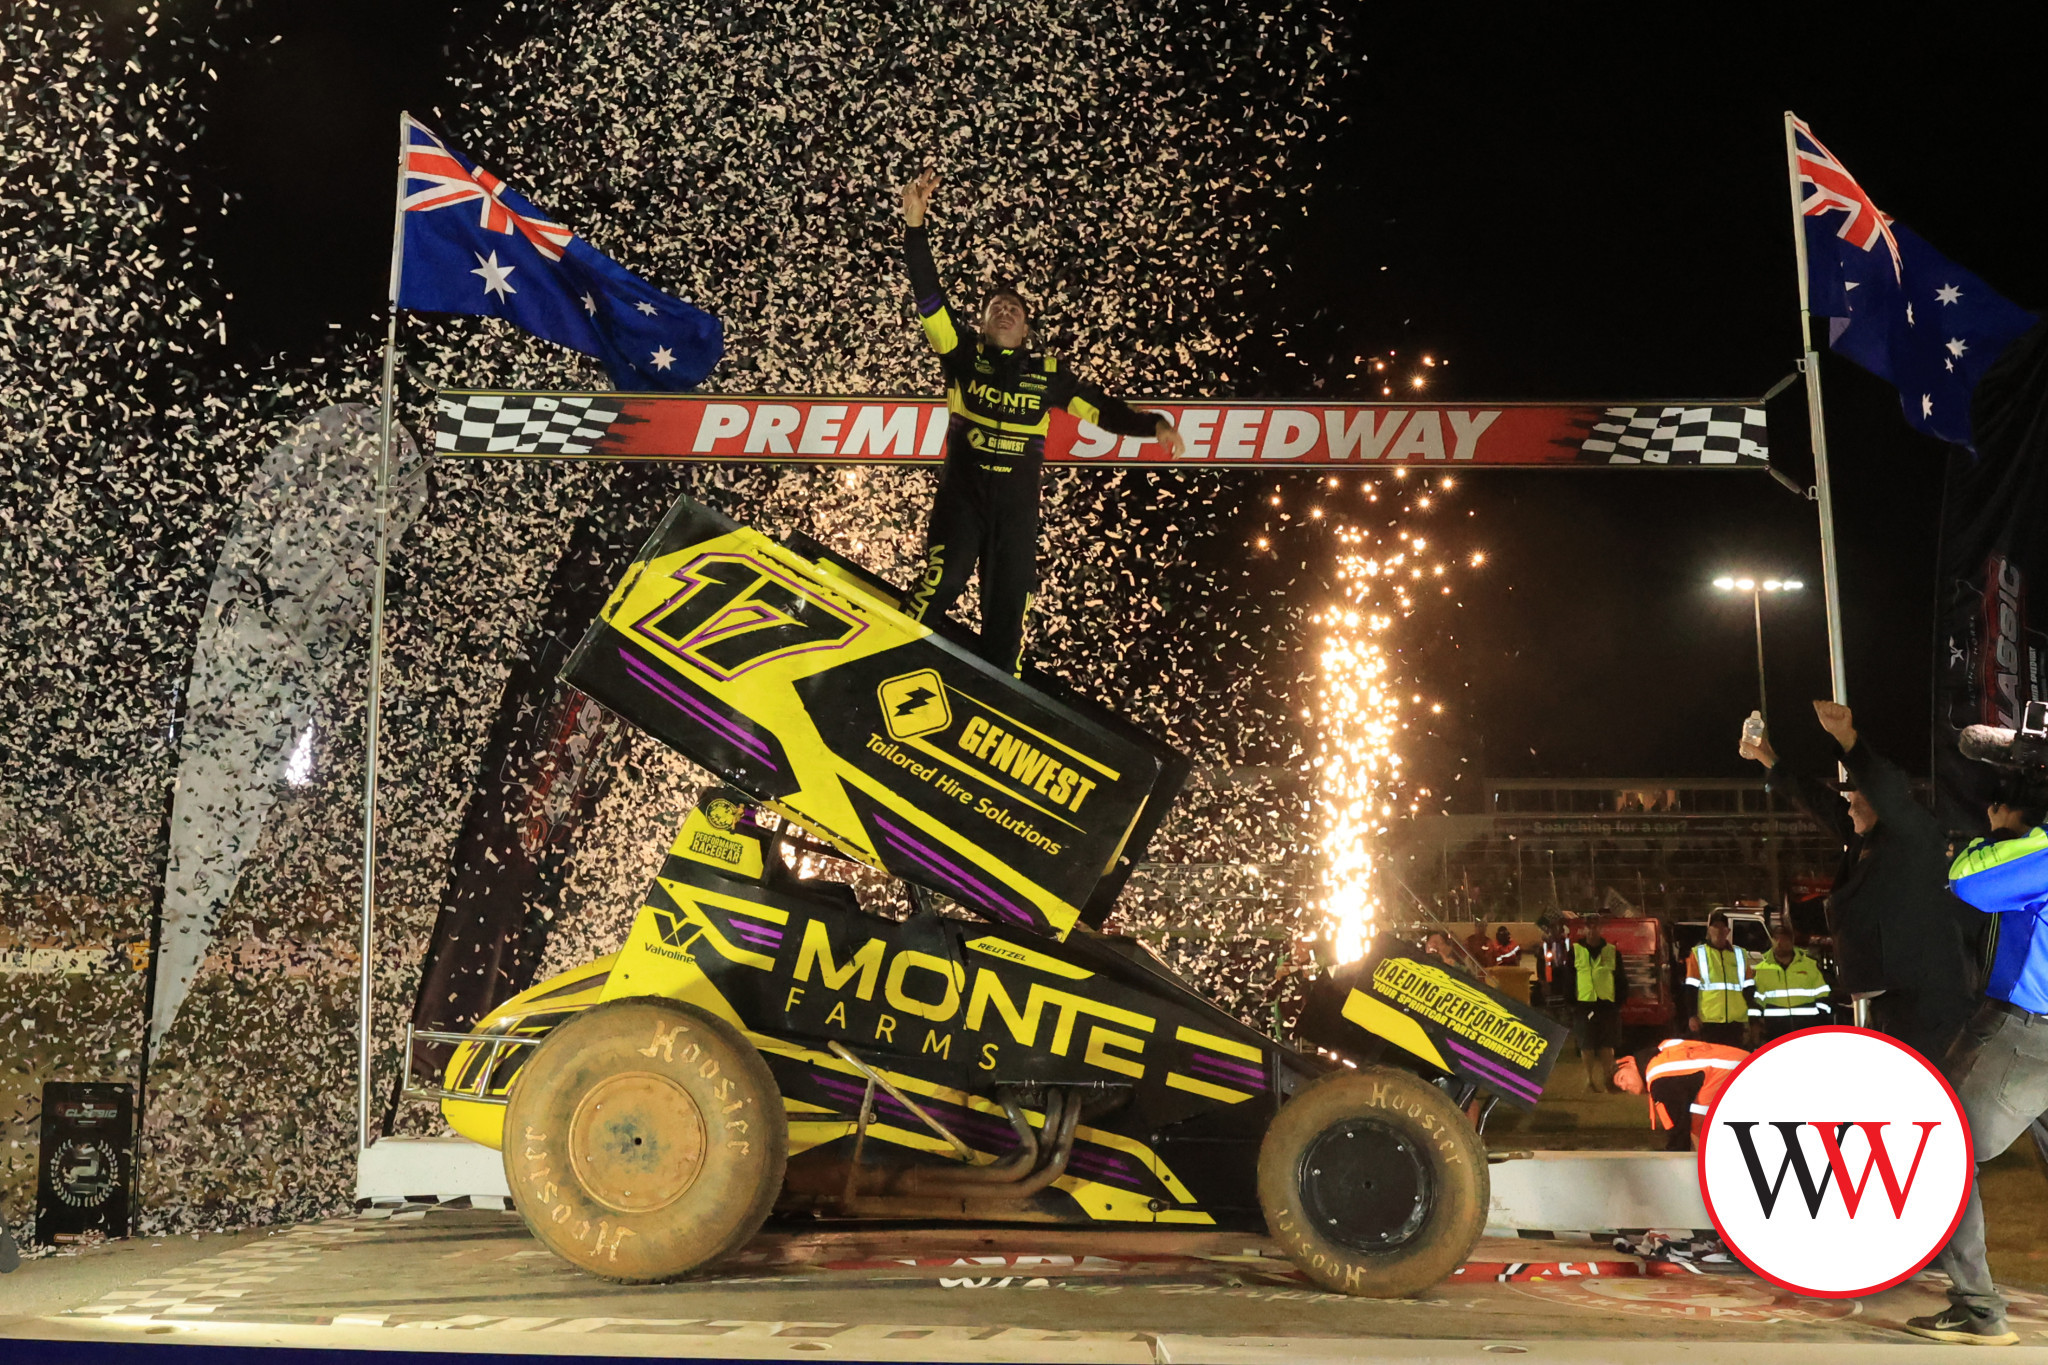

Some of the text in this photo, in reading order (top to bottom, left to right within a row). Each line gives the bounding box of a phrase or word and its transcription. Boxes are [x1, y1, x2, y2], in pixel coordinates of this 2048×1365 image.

[967, 379, 1042, 410] MONTE
[692, 403, 948, 456] PREMI
[640, 554, 866, 678] 17
[1996, 559, 2020, 729] LASSIC
[865, 732, 1062, 855] Tailored Hire Solutions
[957, 715, 1097, 813] GENWEST
[691, 840, 741, 864] RACEGEAR
[694, 832, 743, 851] PERFORMANCE
[644, 942, 694, 965] Valvoline
[977, 941, 1027, 963] REUTZEL
[784, 986, 999, 1071] FARMS
[792, 918, 1157, 1079] MONTE
[1374, 959, 1546, 1058] KAEDING PERFORMANCE
[1397, 990, 1449, 1026] SPRINTCAR
[1447, 1019, 1478, 1041] PARTS
